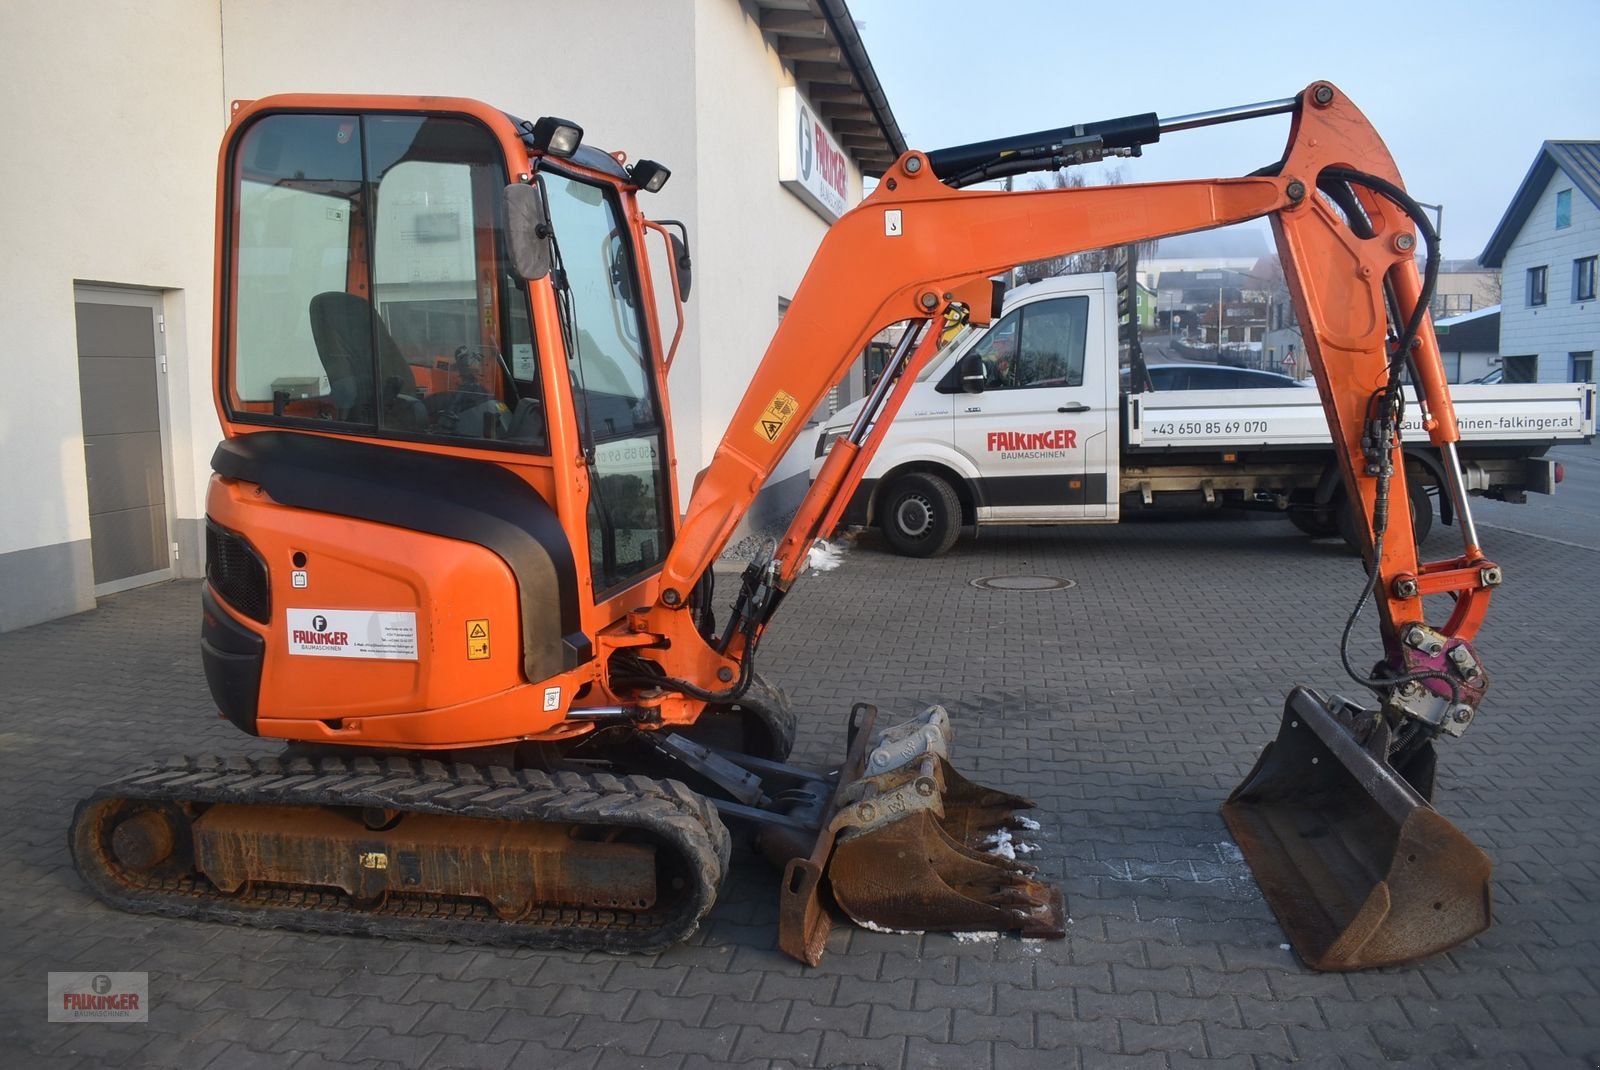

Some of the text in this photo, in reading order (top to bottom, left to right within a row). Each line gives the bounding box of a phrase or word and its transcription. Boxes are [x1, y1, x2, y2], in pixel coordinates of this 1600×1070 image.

[1152, 421, 1267, 435] +43 650 85 69 070
[987, 430, 1077, 451] FALKINGER
[1001, 451, 1065, 460] BAUMASCHINEN
[293, 629, 348, 645] FALKINGER
